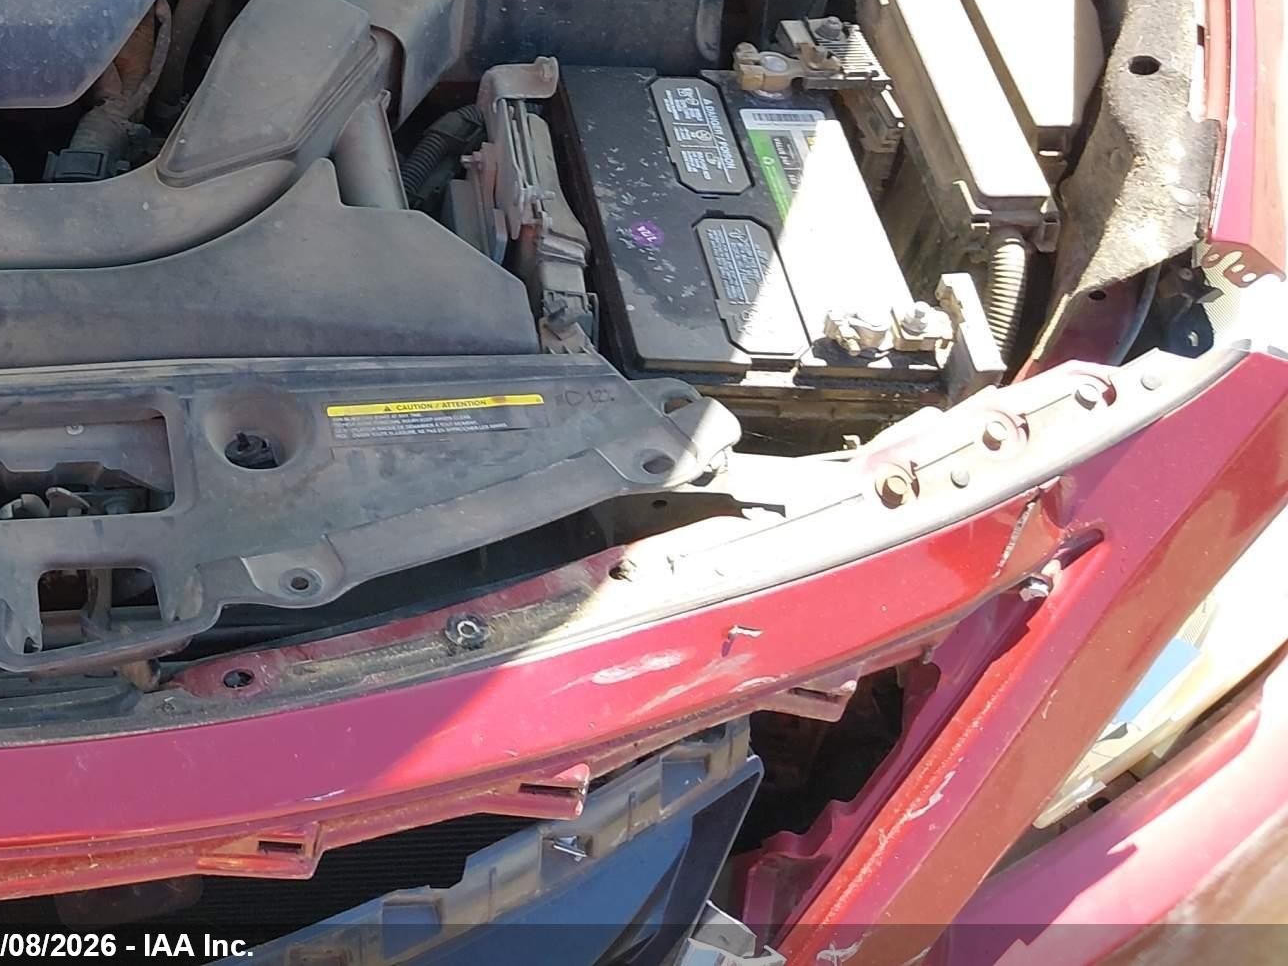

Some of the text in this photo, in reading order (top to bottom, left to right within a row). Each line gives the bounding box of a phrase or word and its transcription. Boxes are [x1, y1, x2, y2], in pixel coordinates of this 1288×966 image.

[705, 106, 723, 135] DANGER
[717, 141, 737, 169] POISON
[396, 402, 433, 411] CAUTION
[441, 399, 488, 409] ATTENTION
